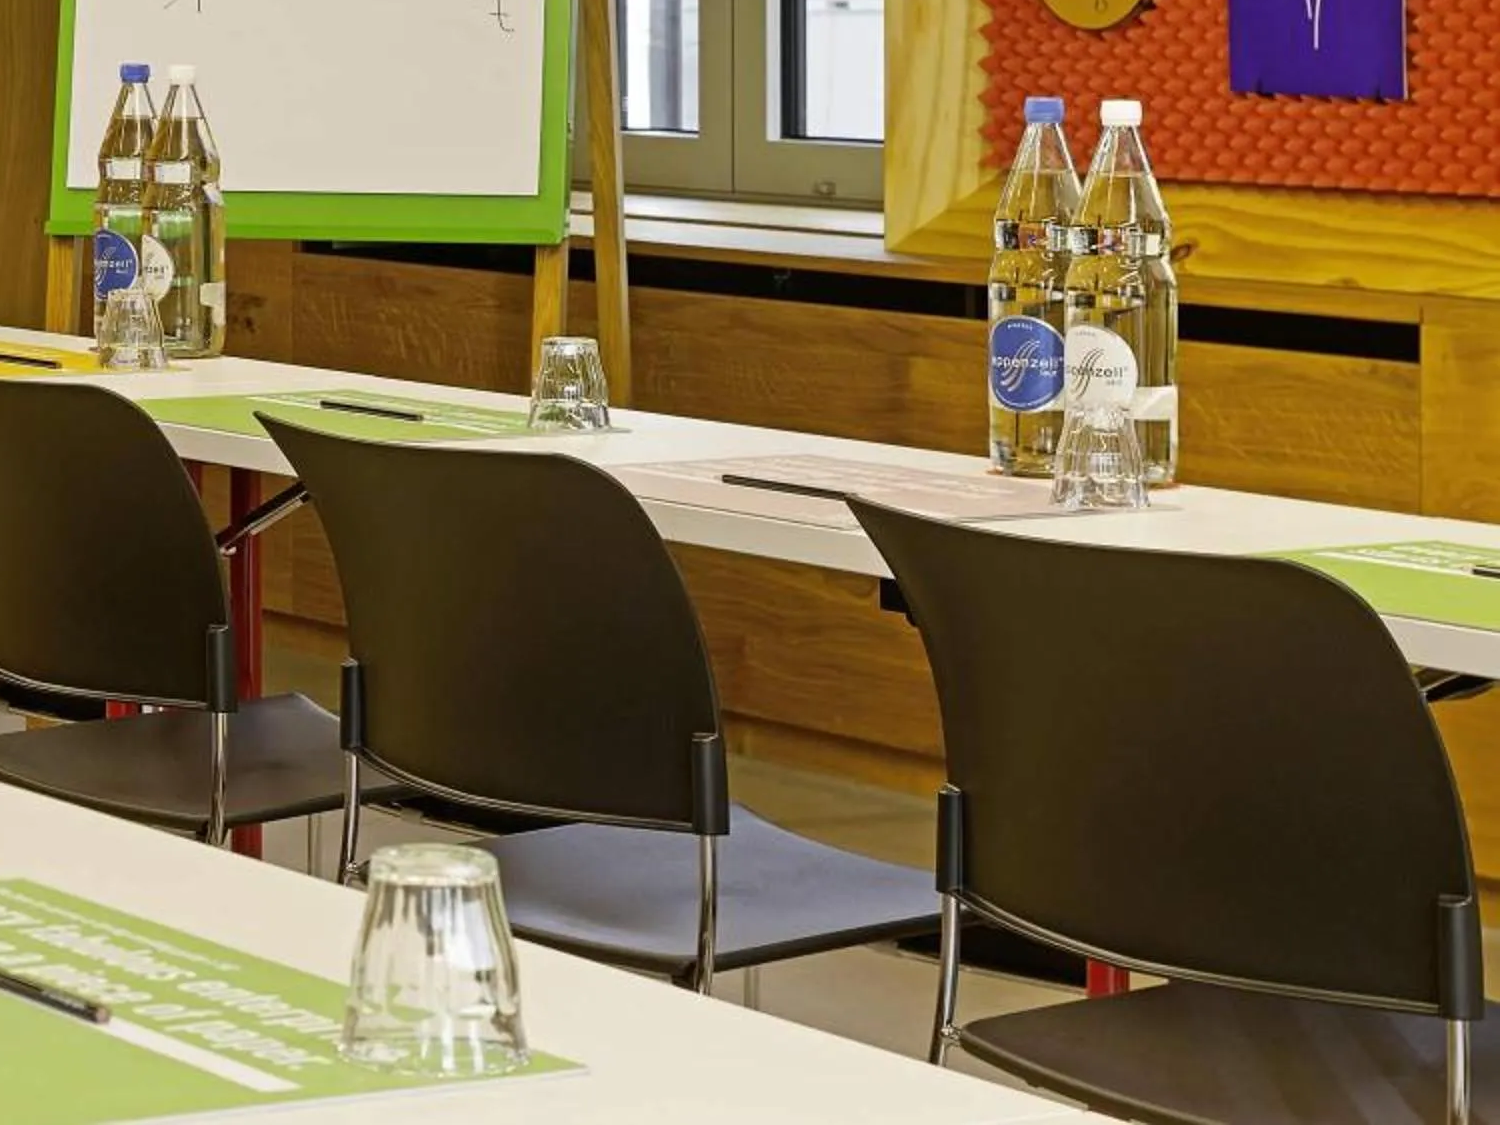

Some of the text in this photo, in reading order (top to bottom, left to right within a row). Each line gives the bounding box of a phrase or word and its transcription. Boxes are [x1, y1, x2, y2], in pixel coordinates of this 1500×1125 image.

[8, 963, 154, 1005] piece
[132, 1002, 223, 1022] of
[17, 924, 197, 981] fabulous
[176, 980, 346, 1044] enterpri
